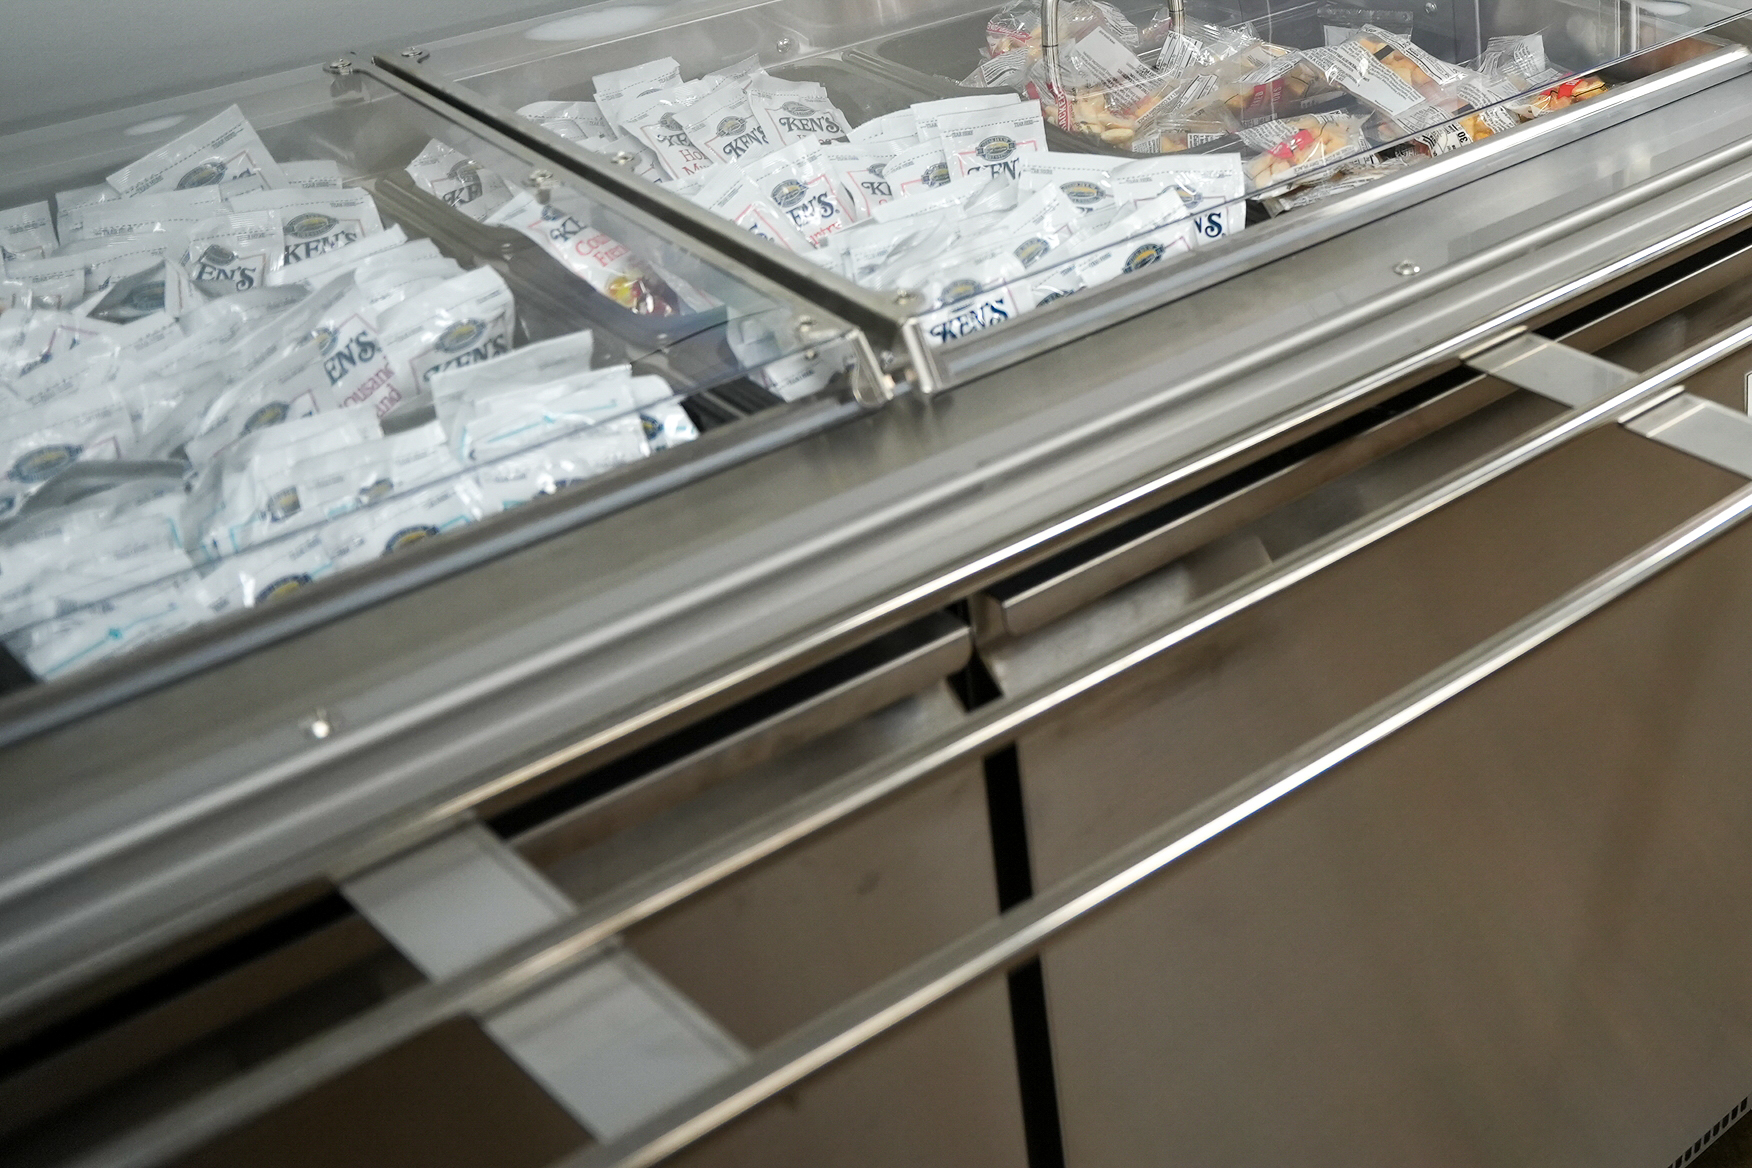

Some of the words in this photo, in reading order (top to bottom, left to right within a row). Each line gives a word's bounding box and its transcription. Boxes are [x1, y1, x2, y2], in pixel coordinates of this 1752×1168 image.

[779, 116, 841, 133] KEN'S
[195, 264, 257, 292] EN'S
[324, 330, 377, 384] EN'S
